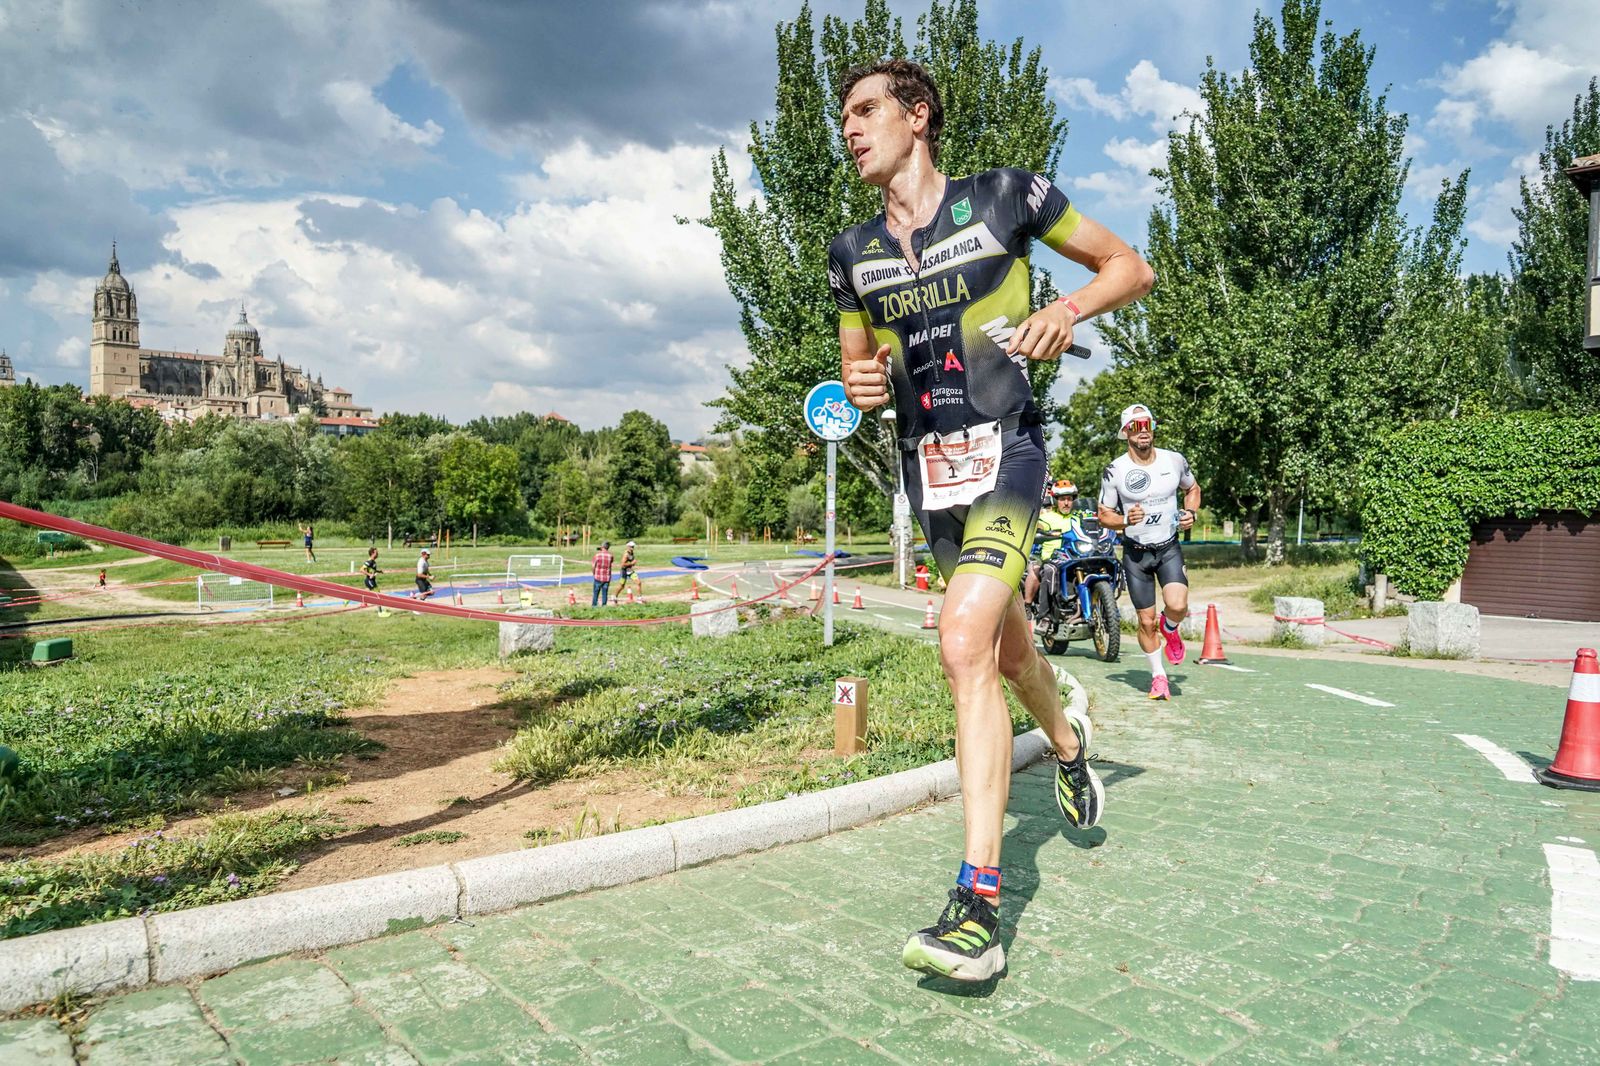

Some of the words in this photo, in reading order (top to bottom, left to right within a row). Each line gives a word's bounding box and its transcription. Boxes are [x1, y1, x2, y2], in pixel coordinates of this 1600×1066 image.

[861, 266, 902, 286] STADIUM
[904, 236, 983, 275] CASABLANCA
[878, 273, 971, 323] ZORRILLA
[908, 323, 952, 347] MAPEI
[931, 387, 963, 397] Zaragoza
[932, 397, 964, 408] DEPORTE
[948, 465, 958, 478] 1
